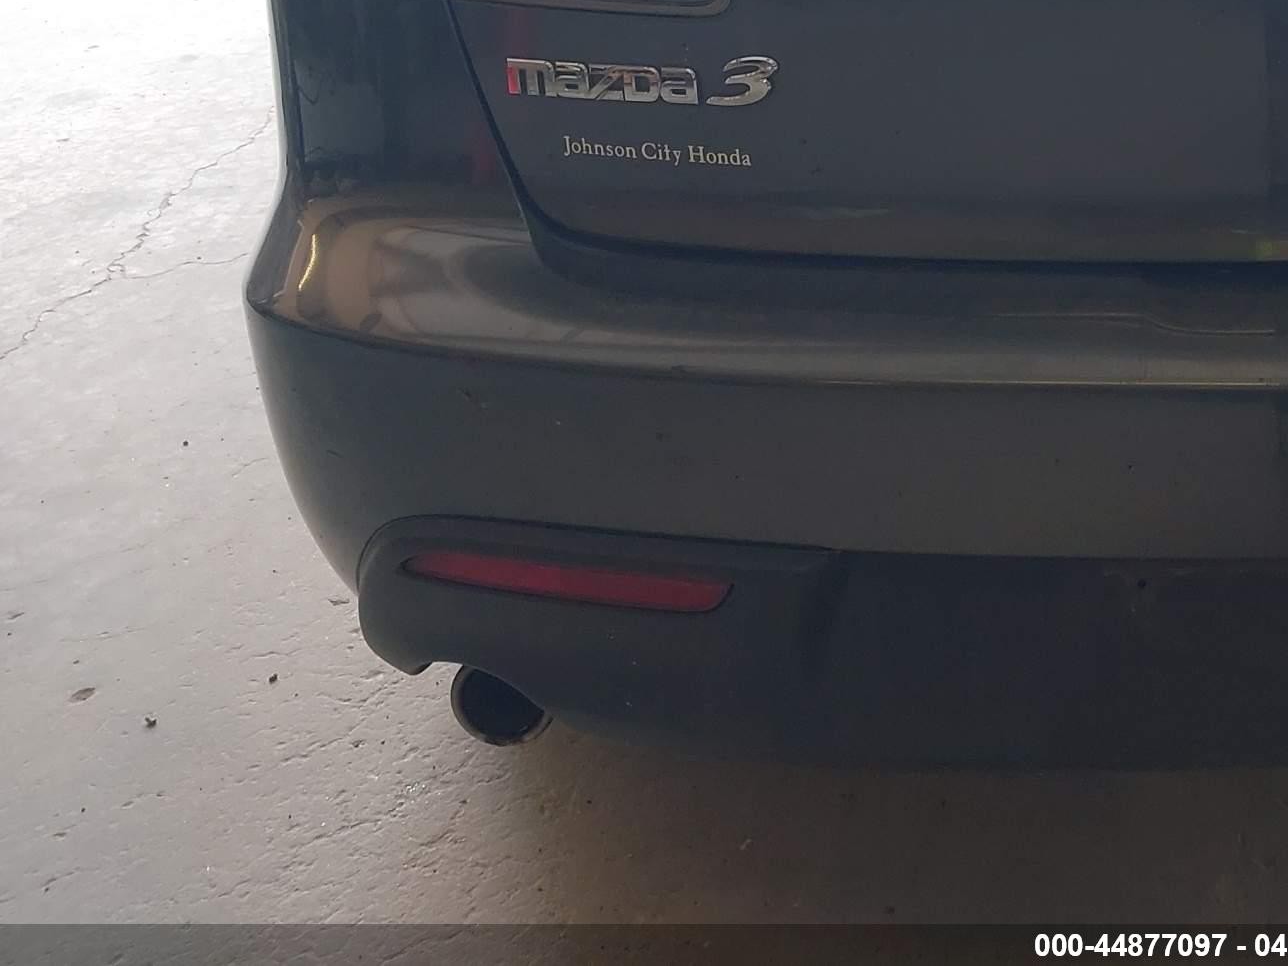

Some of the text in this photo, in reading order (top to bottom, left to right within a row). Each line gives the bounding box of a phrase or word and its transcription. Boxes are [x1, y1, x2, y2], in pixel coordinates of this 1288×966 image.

[705, 55, 779, 106] 3
[563, 135, 752, 167] Johnson City Honda
